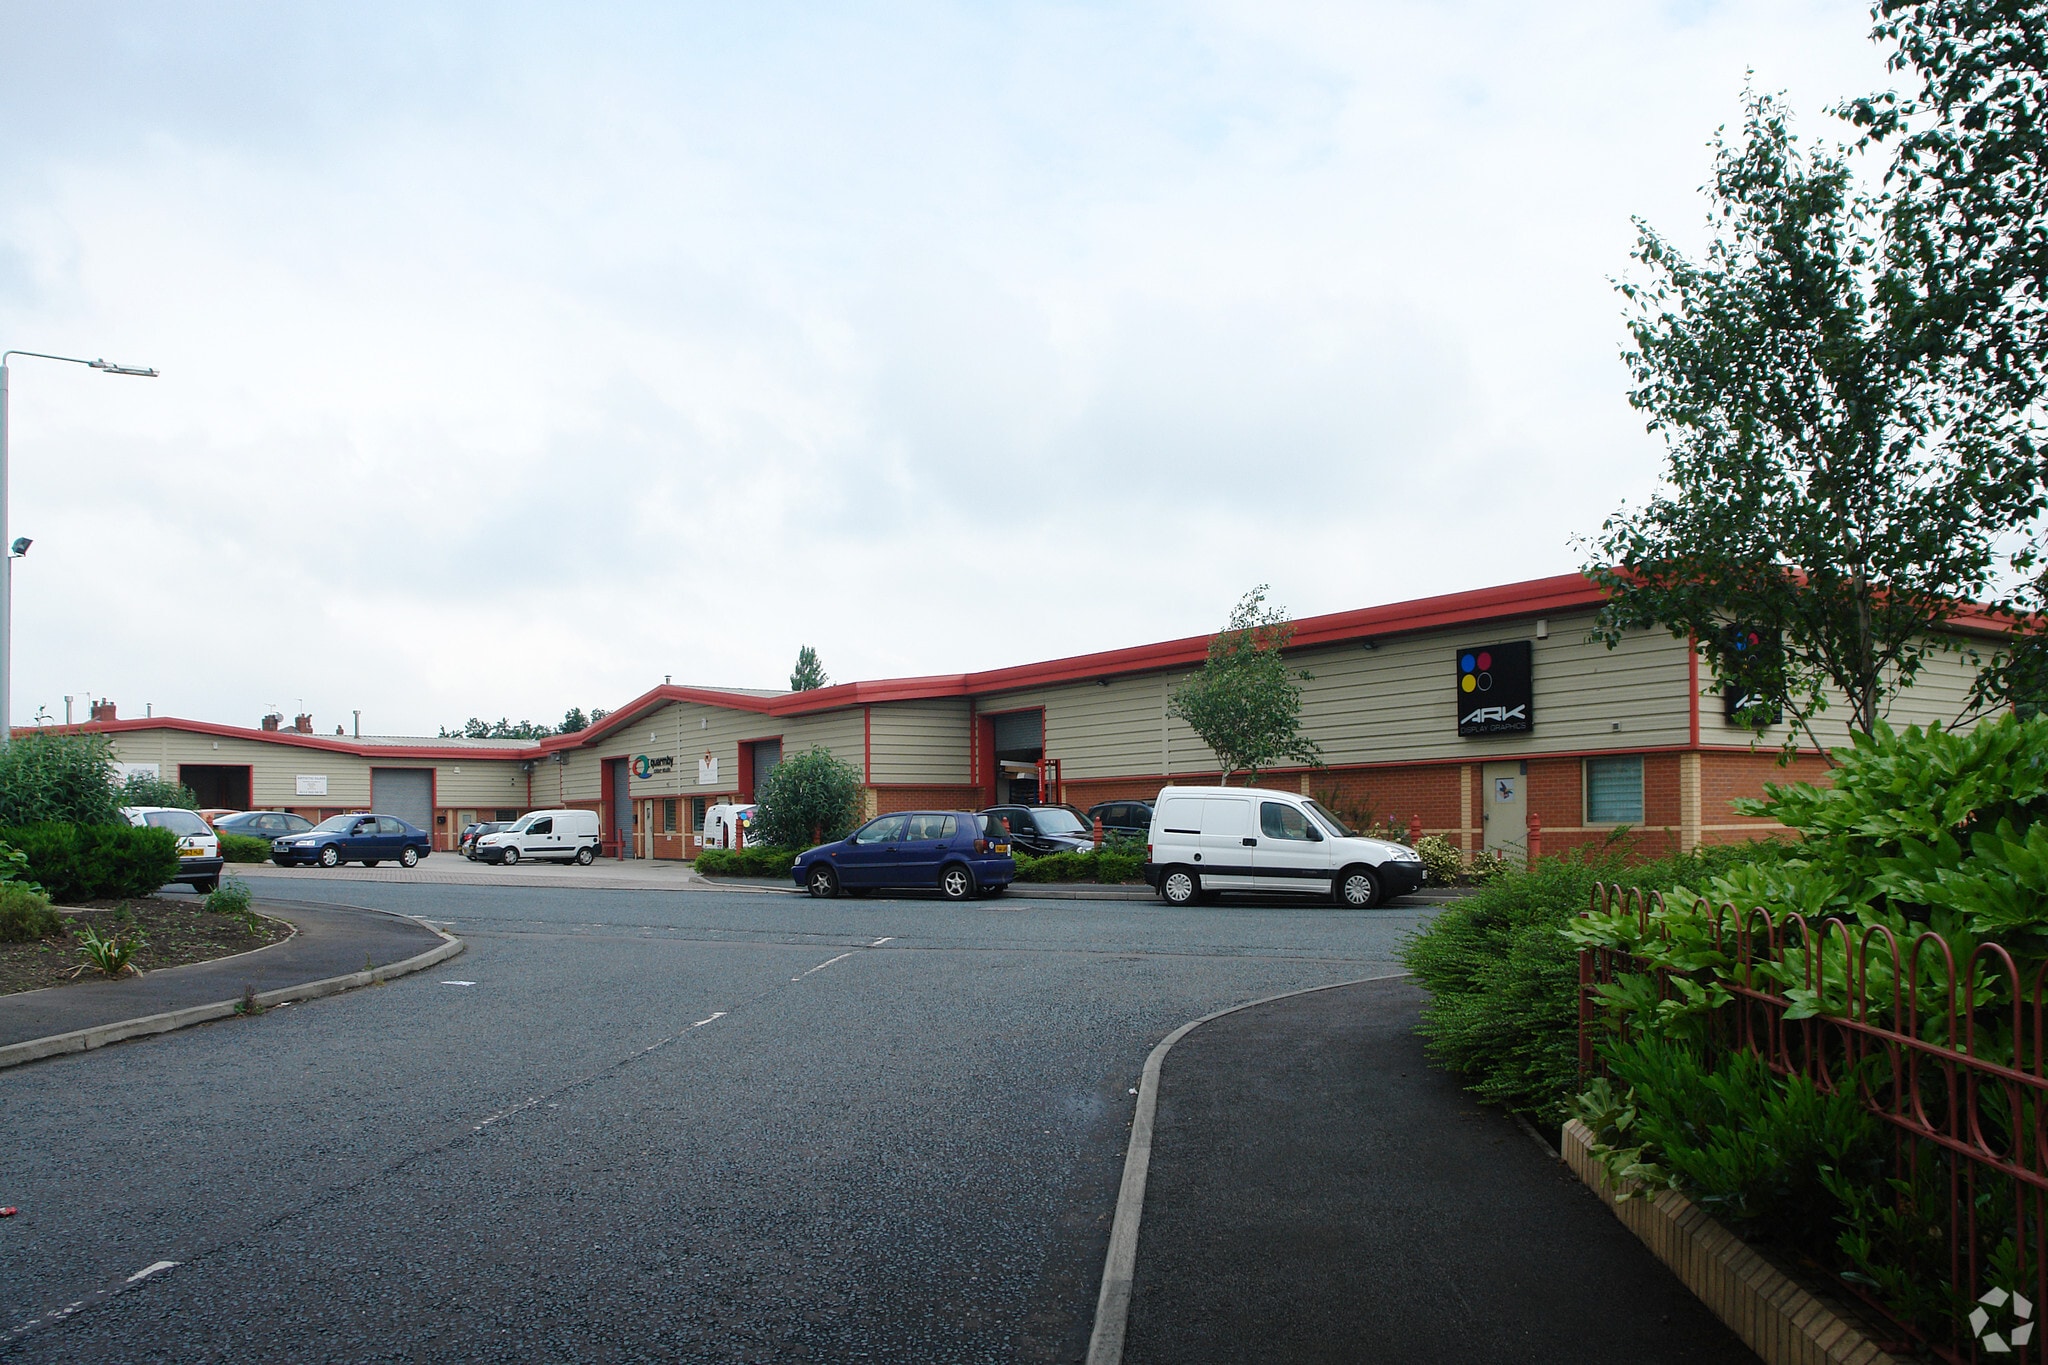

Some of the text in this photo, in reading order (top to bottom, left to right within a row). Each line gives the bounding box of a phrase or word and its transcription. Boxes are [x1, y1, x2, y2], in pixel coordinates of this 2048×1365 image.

[1461, 704, 1526, 724] ARK
[1460, 721, 1526, 734] DISPLAY GRAPHICS
